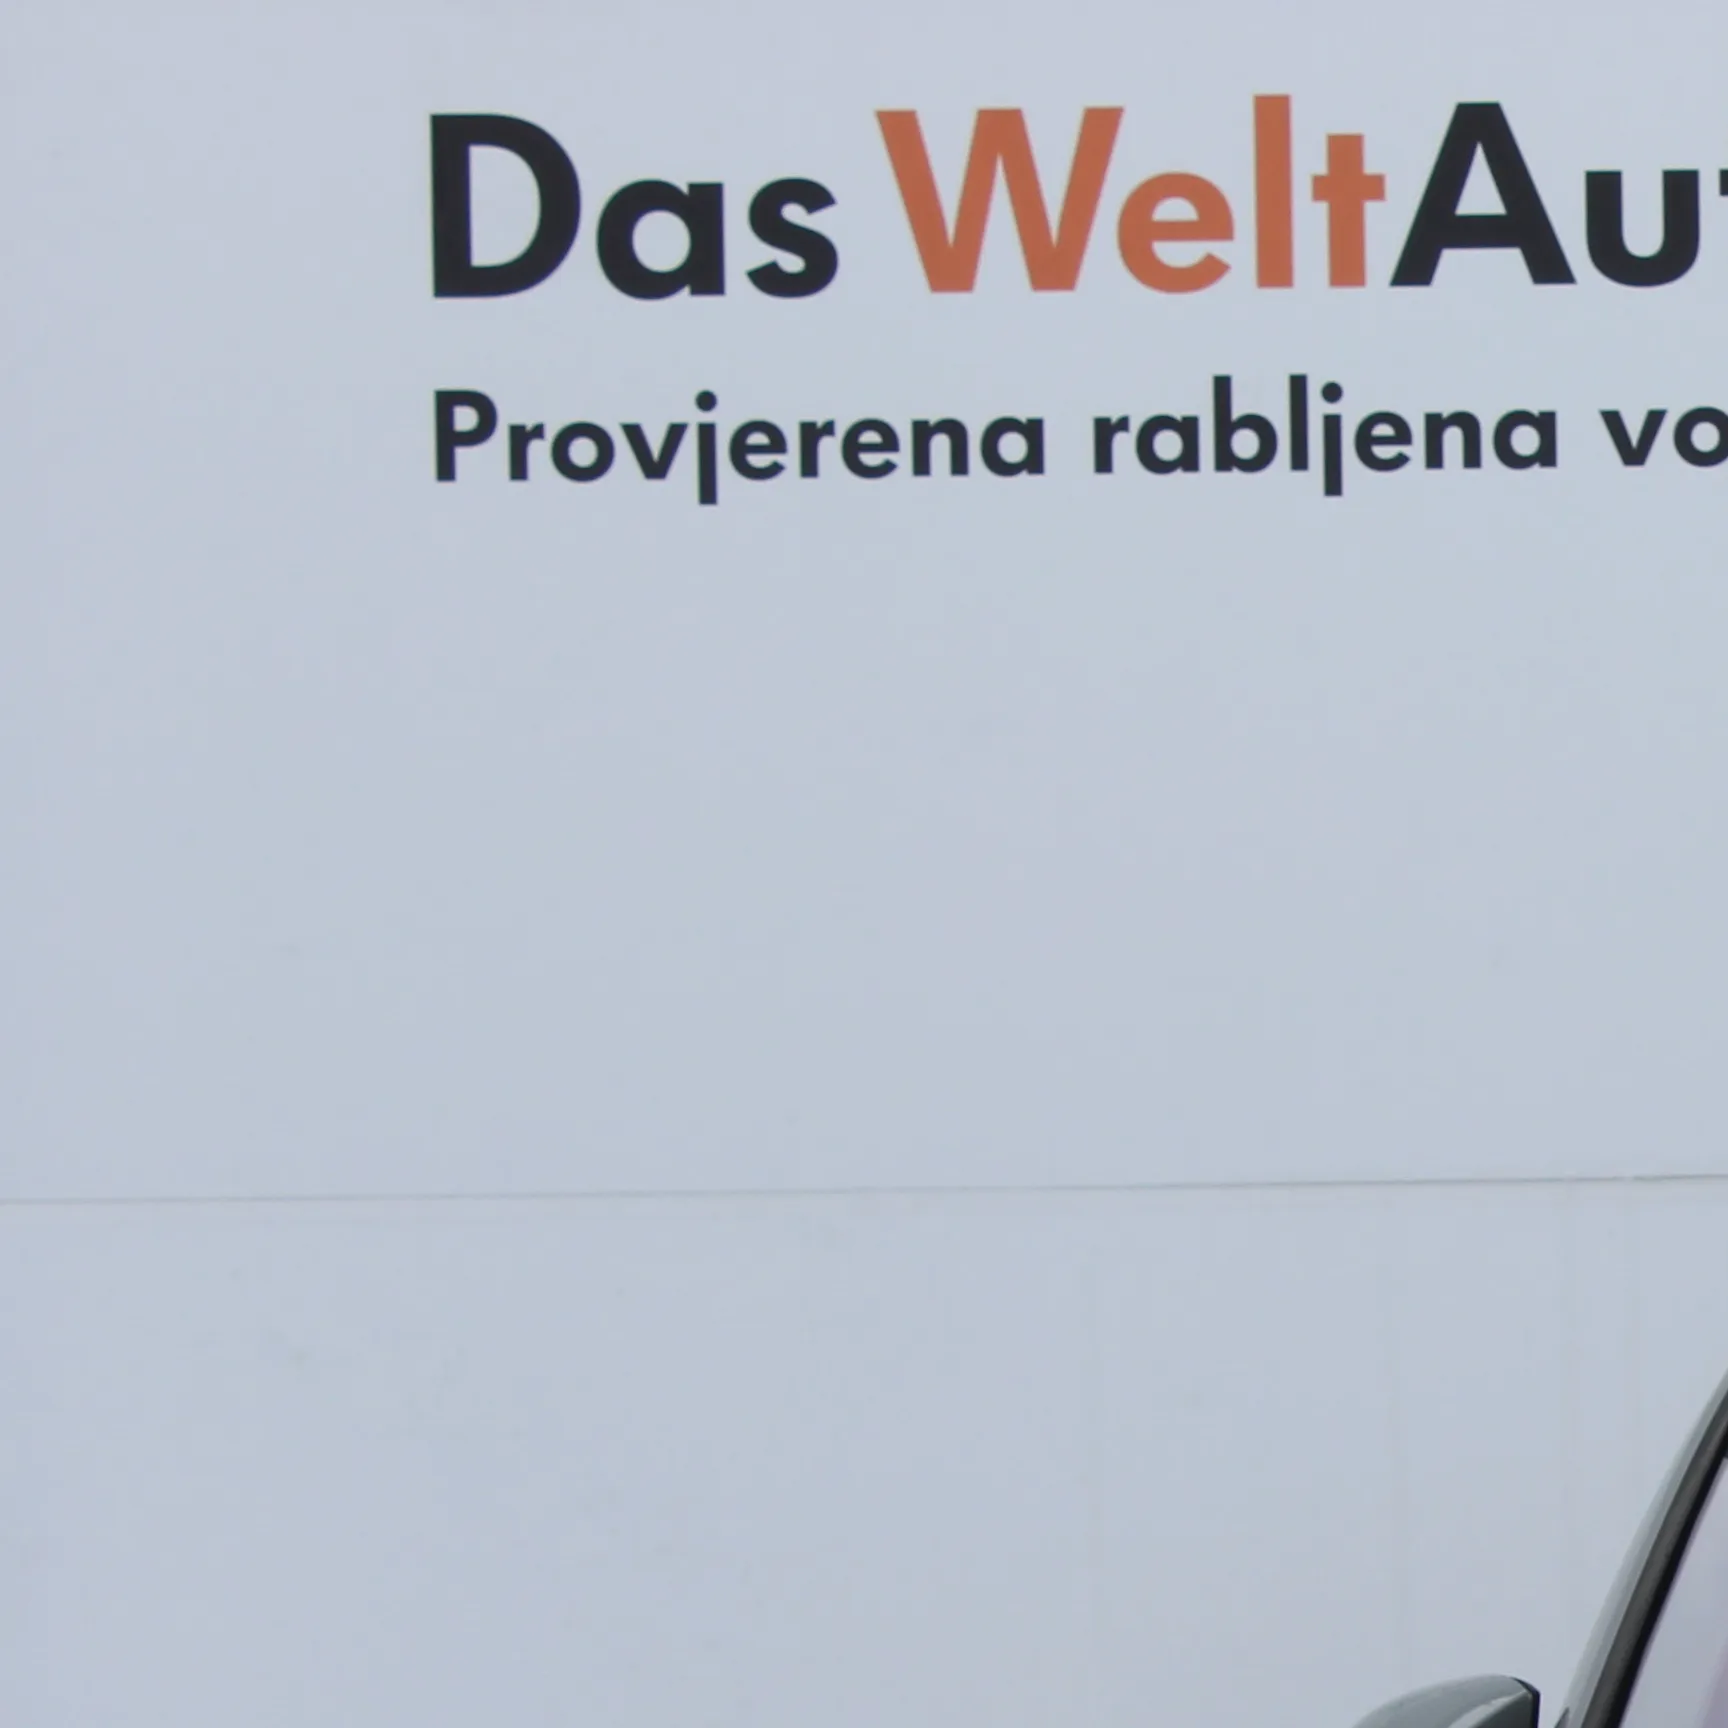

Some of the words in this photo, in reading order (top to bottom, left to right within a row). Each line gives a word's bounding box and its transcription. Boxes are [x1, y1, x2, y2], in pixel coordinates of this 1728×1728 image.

[430, 113, 838, 300] Das
[434, 389, 1044, 505] Provjerena
[1093, 374, 1558, 497] rabljena
